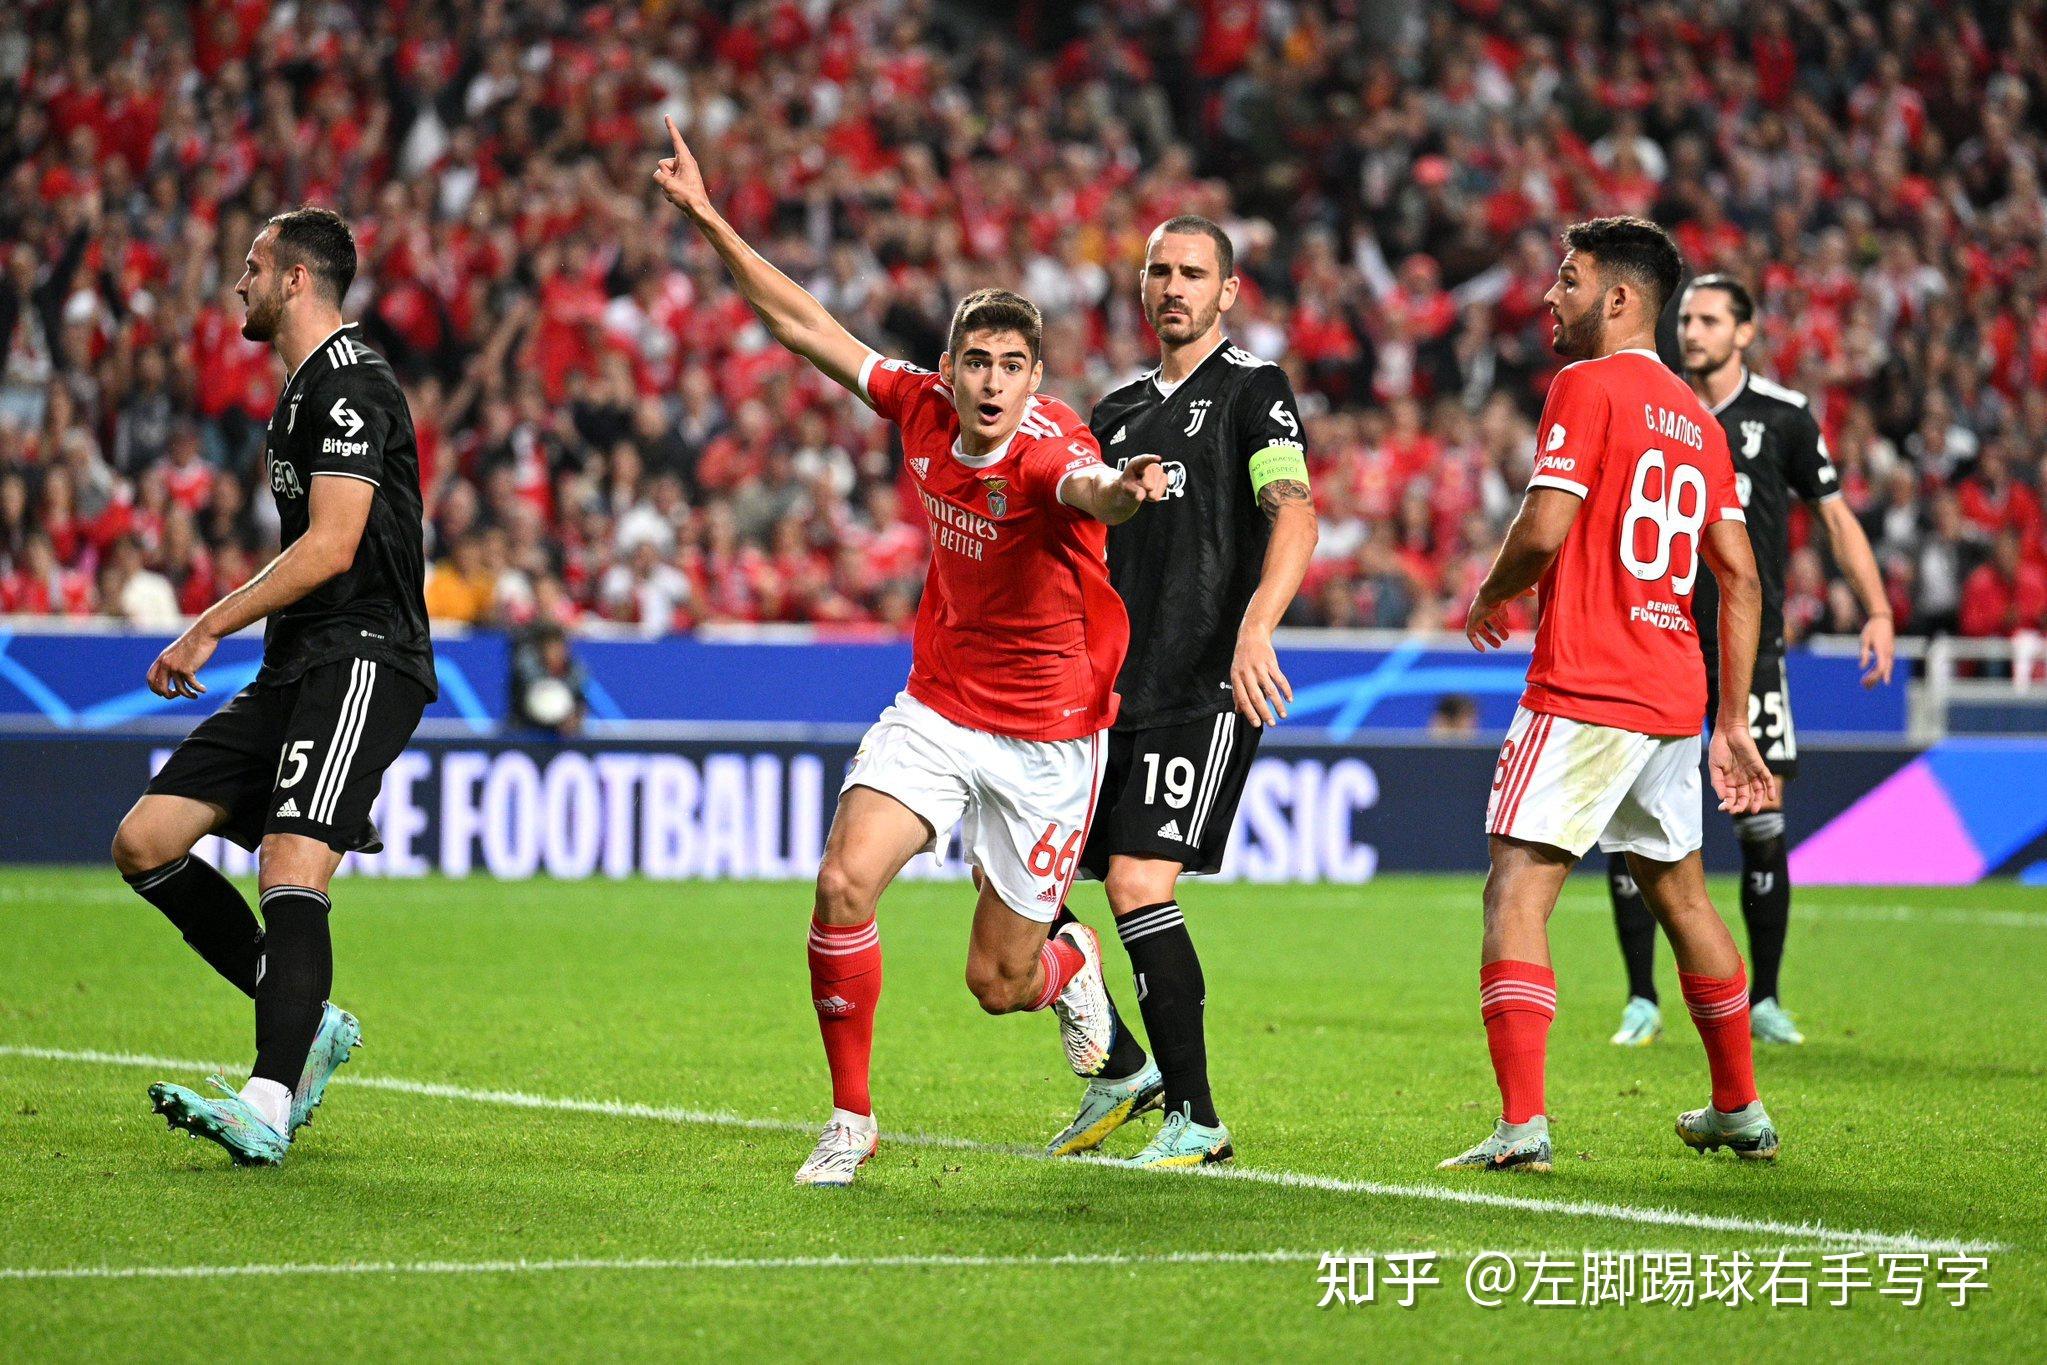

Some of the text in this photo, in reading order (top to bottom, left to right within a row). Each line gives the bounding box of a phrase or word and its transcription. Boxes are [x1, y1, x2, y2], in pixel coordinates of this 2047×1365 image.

[322, 437, 369, 457] Bitget
[940, 526, 983, 562] BETTER
[1618, 447, 1707, 596] 88
[1143, 753, 1196, 809] 19
[440, 750, 825, 880] FOOTBALL
[1027, 822, 1082, 882] 66
